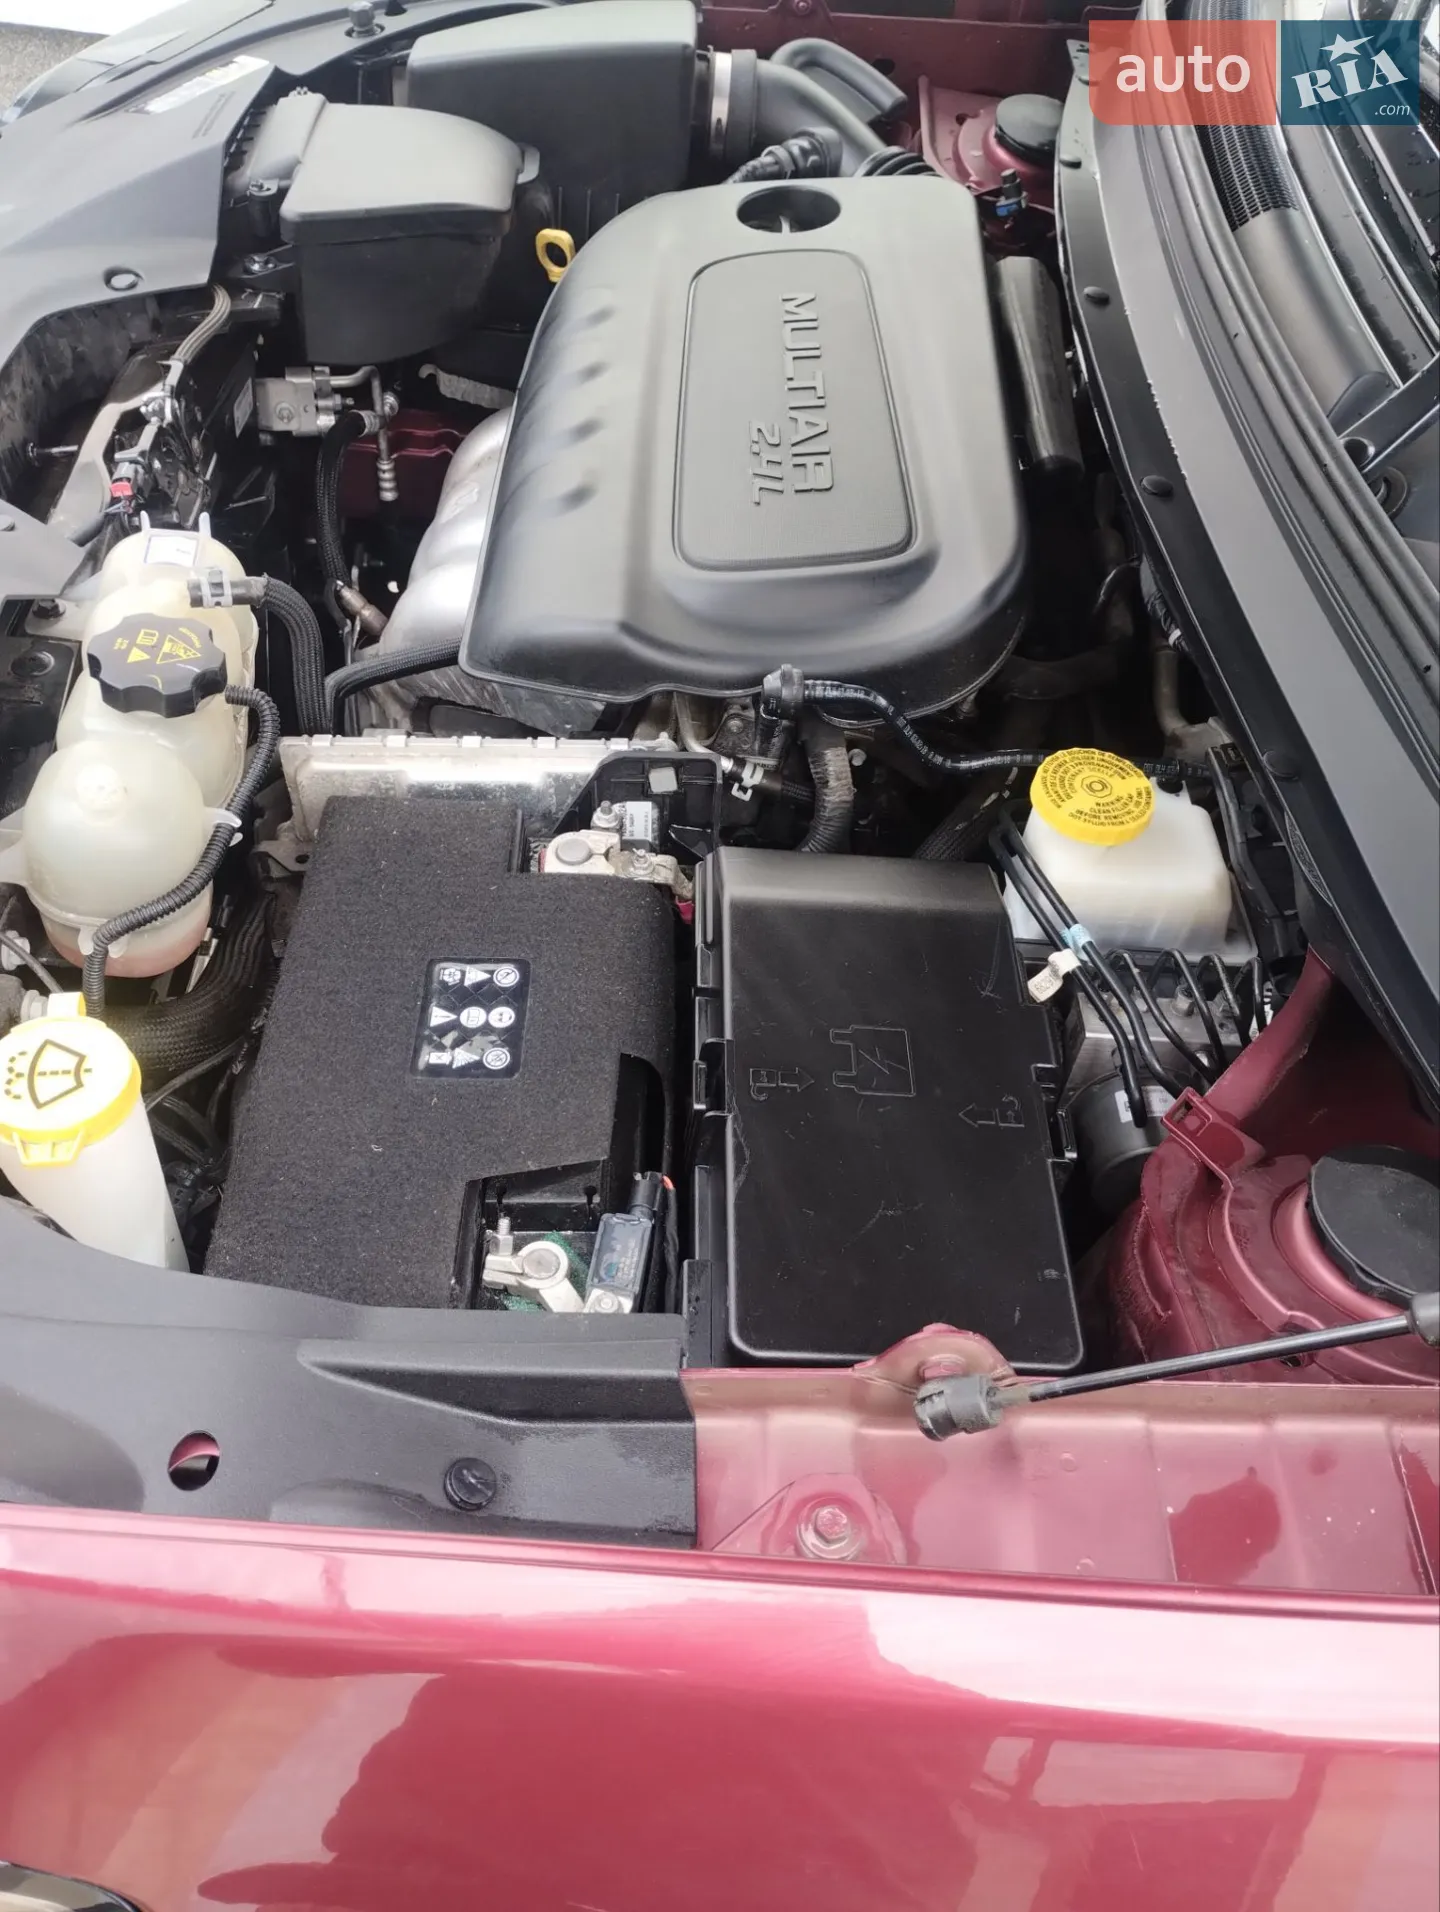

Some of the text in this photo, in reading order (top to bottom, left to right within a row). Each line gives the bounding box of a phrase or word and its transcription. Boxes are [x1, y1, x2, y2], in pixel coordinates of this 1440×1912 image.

[779, 291, 835, 493] MULTIAIR
[748, 419, 785, 506] 2.4L
[1074, 808, 1101, 820] BEFORE
[1089, 806, 1112, 814] CLEAN
